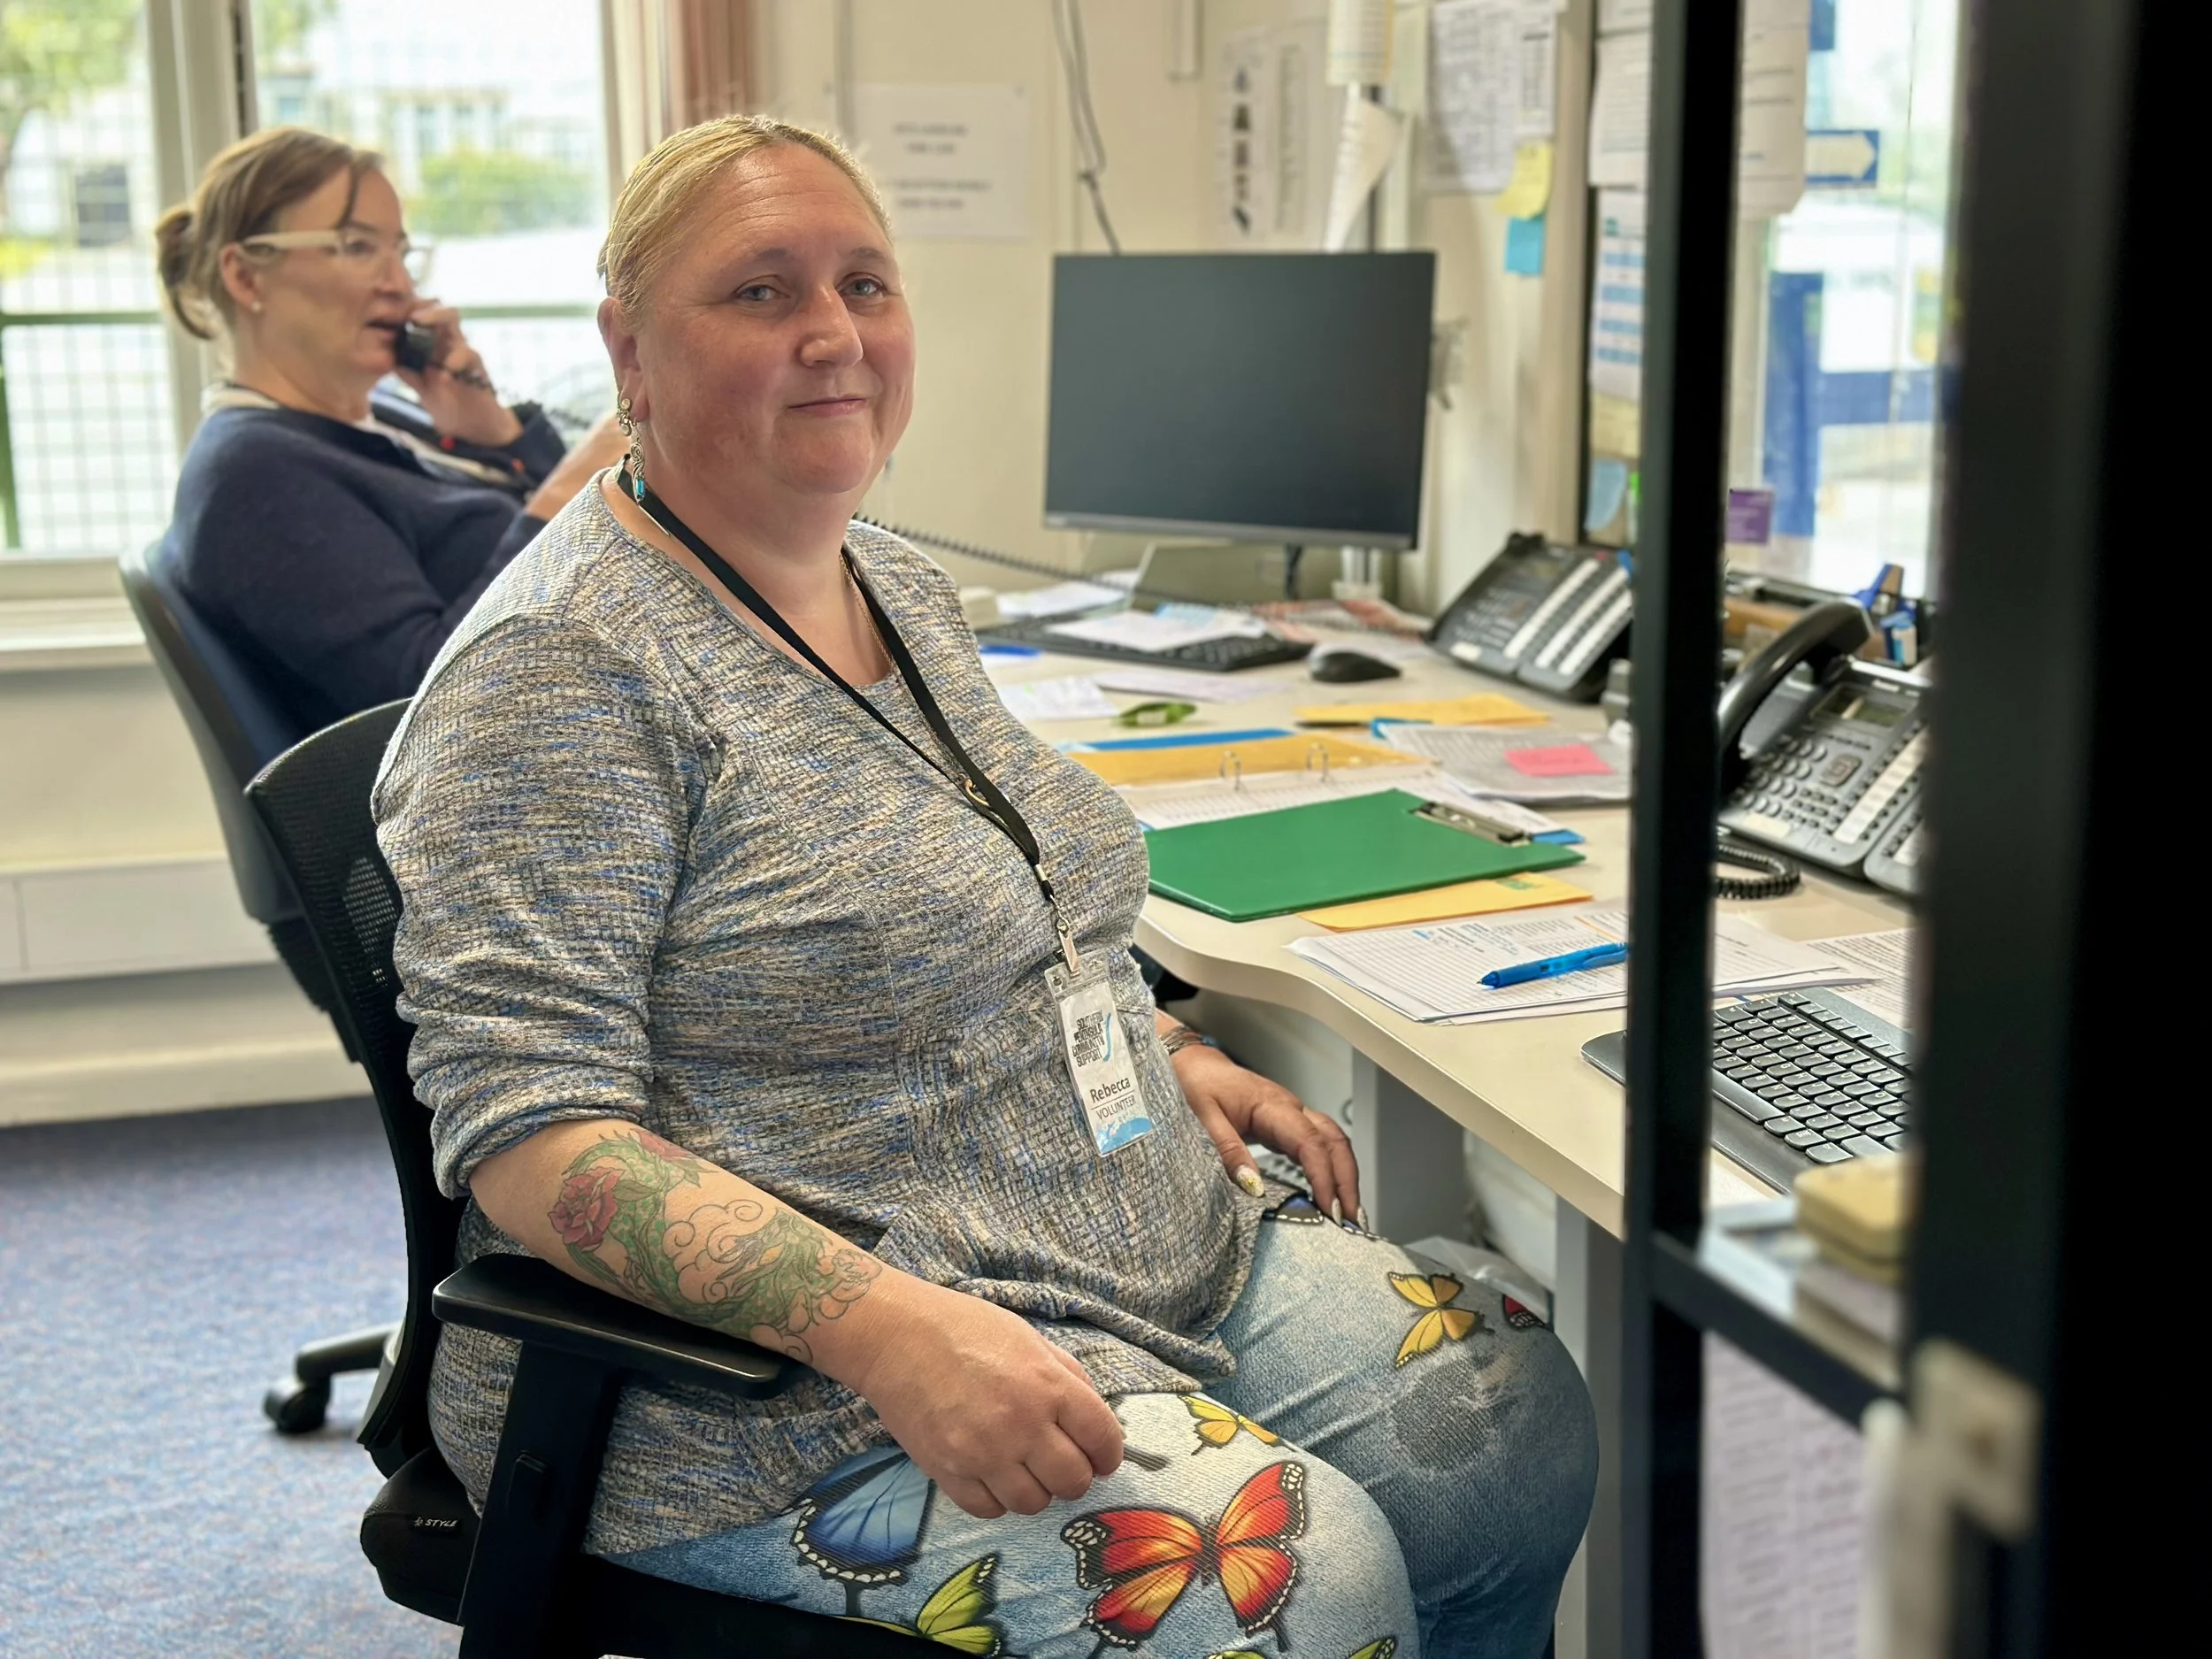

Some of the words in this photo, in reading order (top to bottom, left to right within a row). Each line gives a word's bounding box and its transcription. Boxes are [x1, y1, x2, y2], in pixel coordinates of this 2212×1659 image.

[1077, 1048, 1102, 1067] SUPPORT
[1089, 1078, 1131, 1103] Rebecca
[1095, 1094, 1136, 1119] VOLUNTEER
[425, 1518, 458, 1527] STYLE
